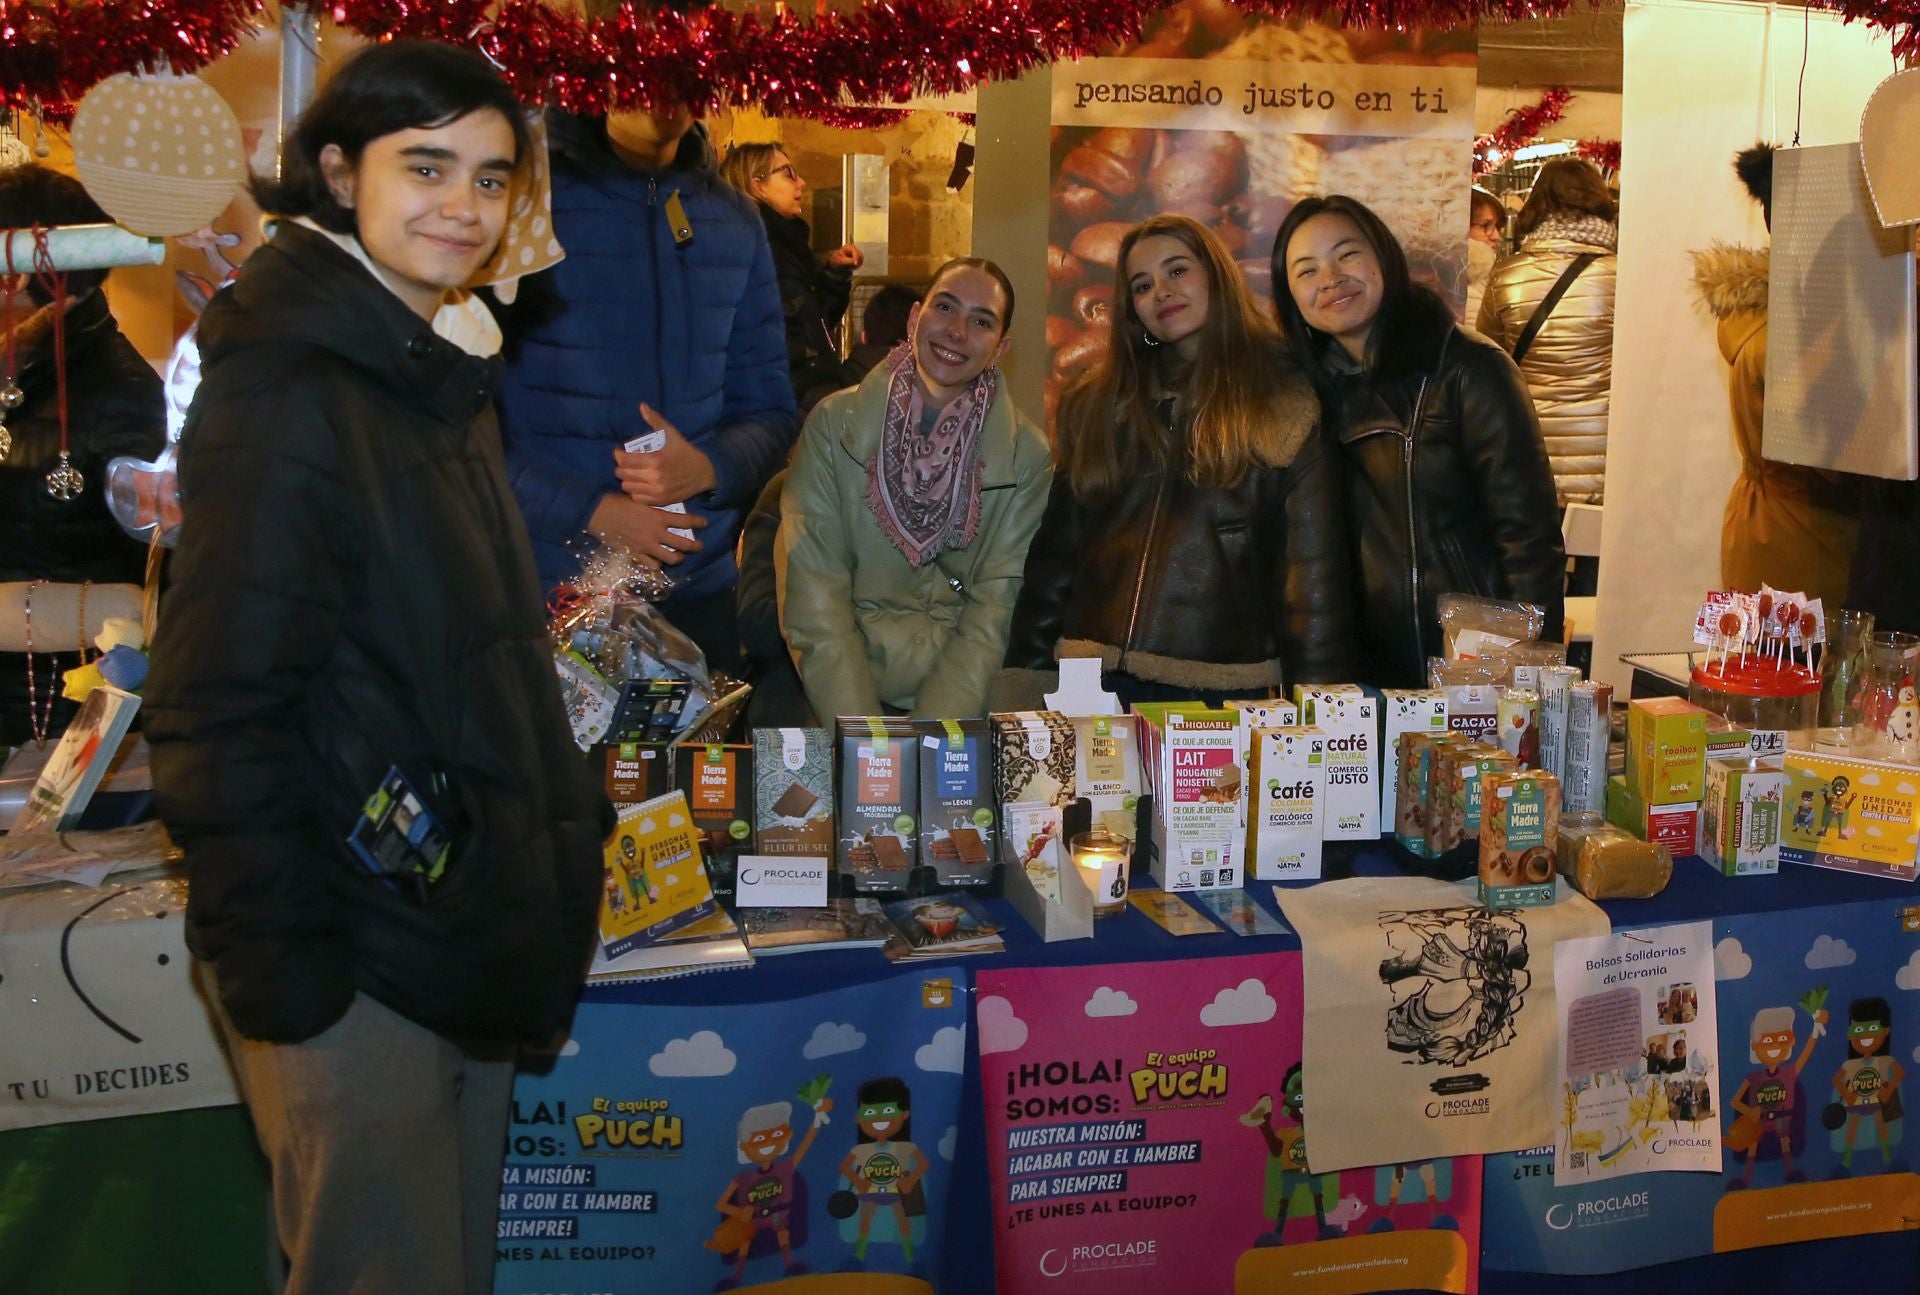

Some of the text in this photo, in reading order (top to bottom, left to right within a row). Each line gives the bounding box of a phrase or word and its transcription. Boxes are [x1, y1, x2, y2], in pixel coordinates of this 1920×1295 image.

[1074, 79, 1449, 115] pensando justo en ti
[1174, 721, 1232, 730] ETHIQUABLE
[1452, 718, 1496, 728] CACAO
[1172, 737, 1233, 746] CE QUE JE CROQUE
[1327, 734, 1368, 751] café
[945, 751, 969, 762] Tierra
[1327, 752, 1368, 760] NATURAL
[1665, 746, 1697, 755] rooibos
[616, 760, 640, 770] Tierra
[868, 756, 892, 767] Tierra
[1175, 751, 1206, 766] LAIT
[613, 769, 640, 779] Madre
[702, 765, 727, 776] Tierra
[866, 767, 893, 778] Madre
[944, 762, 970, 773] Madre
[1176, 768, 1224, 777] NOUGATINE
[701, 775, 728, 786] Madre
[1176, 778, 1216, 787] NOISETTE
[1328, 773, 1369, 785] JUSTO
[1093, 783, 1121, 791] BLANCO
[1271, 780, 1314, 800] café
[856, 805, 902, 813] ALMENDRAS
[1270, 799, 1313, 807] COLOMBIA
[1512, 802, 1539, 814] Tierra
[1861, 802, 1912, 816] UNIDAS
[1863, 795, 1913, 808] PERSONAS
[1173, 806, 1182, 814] CE
[1182, 806, 1196, 814] QUE
[1196, 806, 1205, 814] JE
[1269, 812, 1313, 822] ECOLÓGICO
[1511, 815, 1540, 827] Madre
[1734, 803, 1743, 847] ETHIQUABLE
[1752, 813, 1760, 831] VERT
[1759, 808, 1767, 844] EARL GREY
[649, 832, 689, 852] PERSONAS
[764, 843, 830, 853] FLEUR DE SEL
[651, 840, 692, 862] UNIDAS
[763, 869, 823, 879] PROCLADE
[1586, 945, 1687, 971] Bolsas Solidarias
[1603, 965, 1668, 985] de Ucrania
[1147, 1048, 1217, 1067] El equipo
[9, 1062, 190, 1101] TU DECIDES
[1007, 1059, 1123, 1095] ¡HOLA!
[1130, 1064, 1228, 1103] PUCH
[1851, 1078, 1882, 1091] PUCH
[1443, 1098, 1490, 1110] PROCLADE
[1756, 1091, 1787, 1104] PUCH
[592, 1097, 669, 1115] El equipo
[1006, 1095, 1120, 1121] SOMOS:
[574, 1114, 683, 1148] PUCH
[1008, 1120, 1143, 1150] NUESTRA MISIÓN:
[1668, 1138, 1713, 1149] PROCLADE
[1009, 1143, 1197, 1175] ¡ACABAR CON EL HAMBRE
[1289, 1149, 1306, 1160] PU
[525, 1165, 592, 1185] MISIÓN:
[864, 1164, 902, 1179] PUCH
[1513, 1164, 1542, 1180] ¿TE
[747, 1184, 784, 1203] PUCH
[1010, 1172, 1123, 1201] PARA SIEMPRE!
[523, 1193, 556, 1210] CON
[562, 1193, 579, 1210] EL
[583, 1194, 653, 1211] HAMBRE
[1577, 1192, 1649, 1216] PROCLADE
[1008, 1194, 1197, 1230] ¿TE UNES AL EQUIPO?
[1766, 1200, 1873, 1222] www.fundacionproclade.org
[497, 1220, 573, 1238] SIEMPRE!
[540, 1248, 564, 1261] AL
[570, 1246, 657, 1262] EQUIPO?
[1072, 1240, 1157, 1261] PROCLADE
[1292, 1257, 1409, 1278] www.fundacionproclade.org
